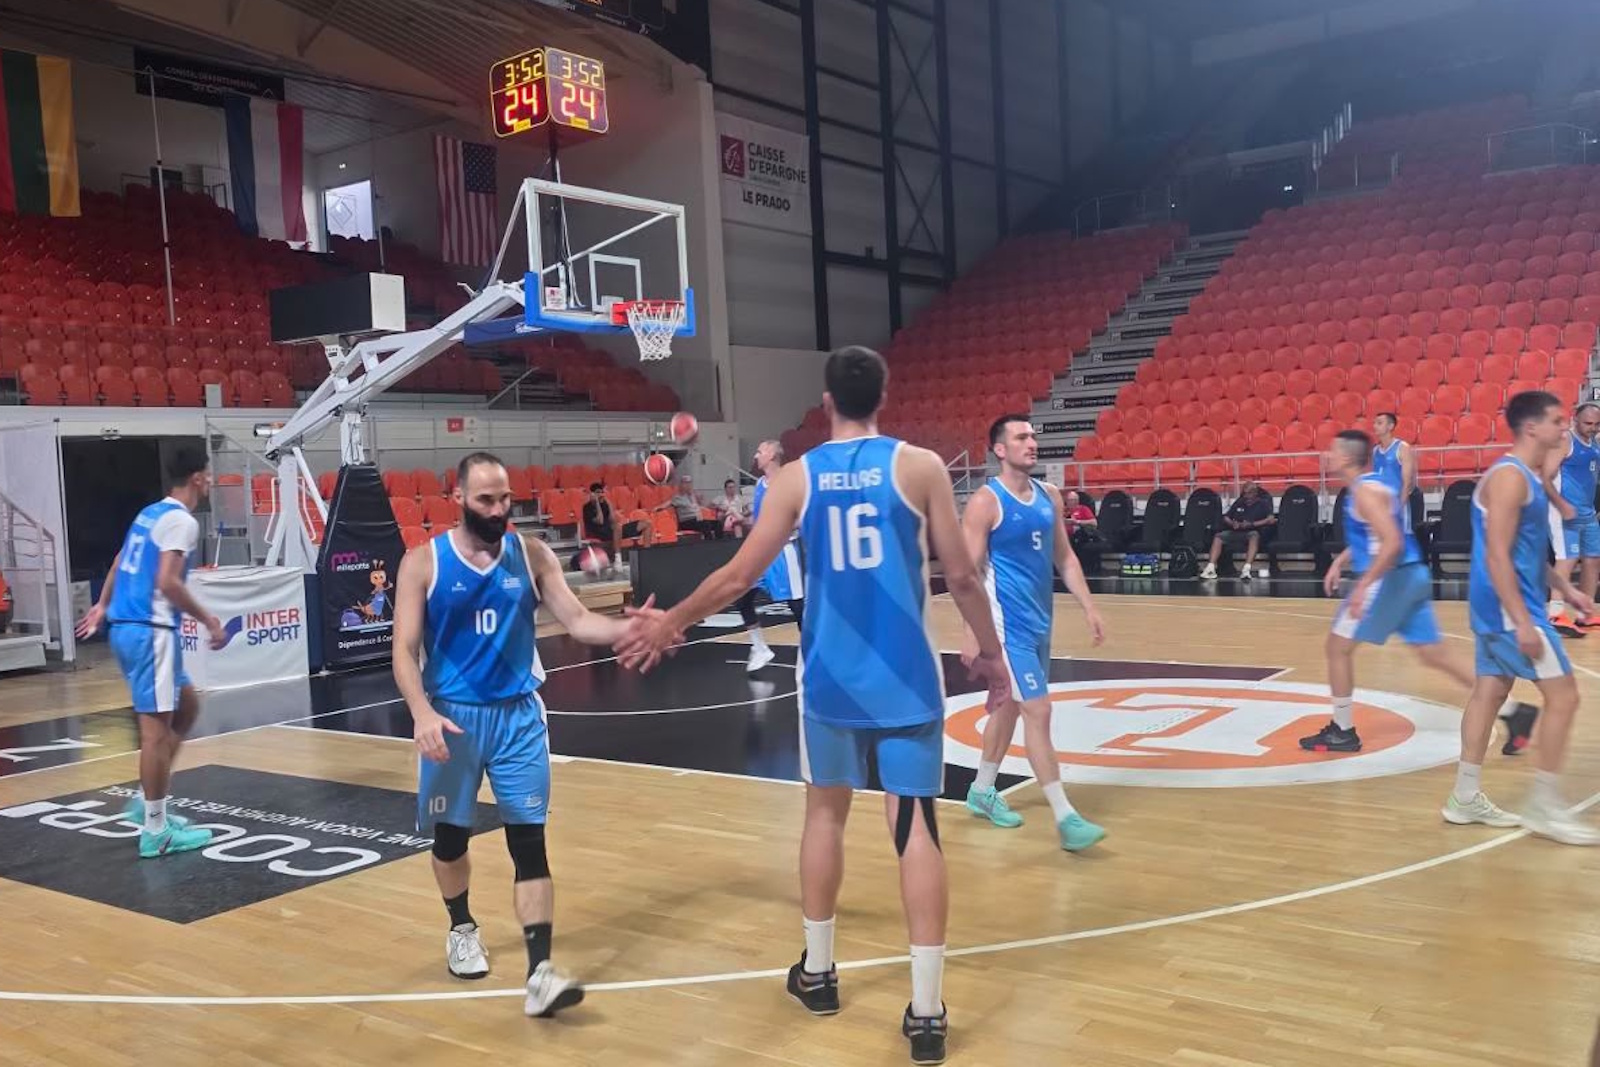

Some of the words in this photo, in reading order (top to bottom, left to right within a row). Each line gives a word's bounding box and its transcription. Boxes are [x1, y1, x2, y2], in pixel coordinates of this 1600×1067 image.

[505, 53, 543, 87] 3:52
[562, 56, 601, 87] 3:52
[504, 83, 538, 126] 24
[561, 82, 596, 121] 24
[747, 142, 786, 163] CAISSE
[748, 158, 807, 184] D'EPARGNE
[742, 189, 754, 204] LE
[755, 192, 791, 211] PRADO
[818, 467, 882, 491] HELLAS
[827, 502, 884, 572] 16
[1031, 531, 1043, 550] 5
[182, 619, 198, 635] ER
[246, 608, 300, 629] INTER
[475, 608, 498, 635] 10
[181, 636, 198, 651] ORT
[246, 624, 301, 646] SPORT
[1024, 672, 1039, 690] 5
[429, 795, 447, 816] 10
